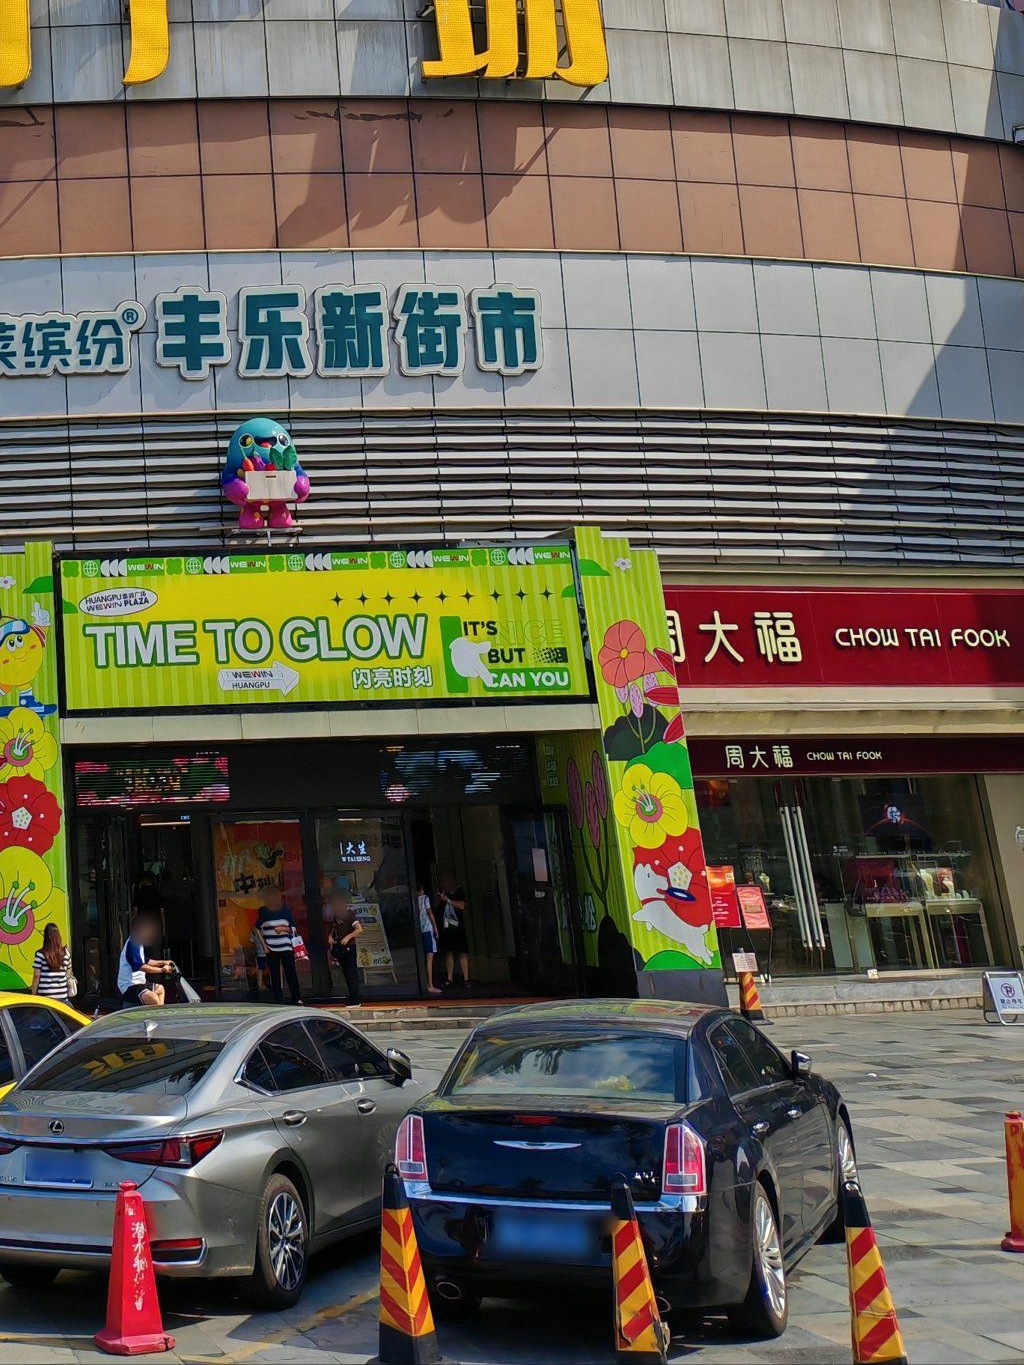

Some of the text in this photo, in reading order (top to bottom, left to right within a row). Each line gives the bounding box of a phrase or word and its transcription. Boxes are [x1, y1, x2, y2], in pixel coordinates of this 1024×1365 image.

[162, 290, 539, 372] 丰乐新街市
[127, 551, 570, 572] WEWIN WEWIN WEWIN WEWIN WEWIN
[85, 594, 122, 605] HUANGPU
[86, 597, 150, 612] WEWIN PLAZA
[84, 615, 427, 668] TIME TO GLOW
[835, 627, 1011, 648] CHOW TAI FOOK
[488, 647, 526, 664] BUT
[231, 669, 274, 679] WEWIN
[353, 666, 433, 689] 闪亮时刻
[489, 671, 570, 688] CAN YOU
[231, 681, 271, 690] HUANGPU
[725, 745, 794, 769] 周大福
[806, 751, 883, 761] CHOW TAI FOOK
